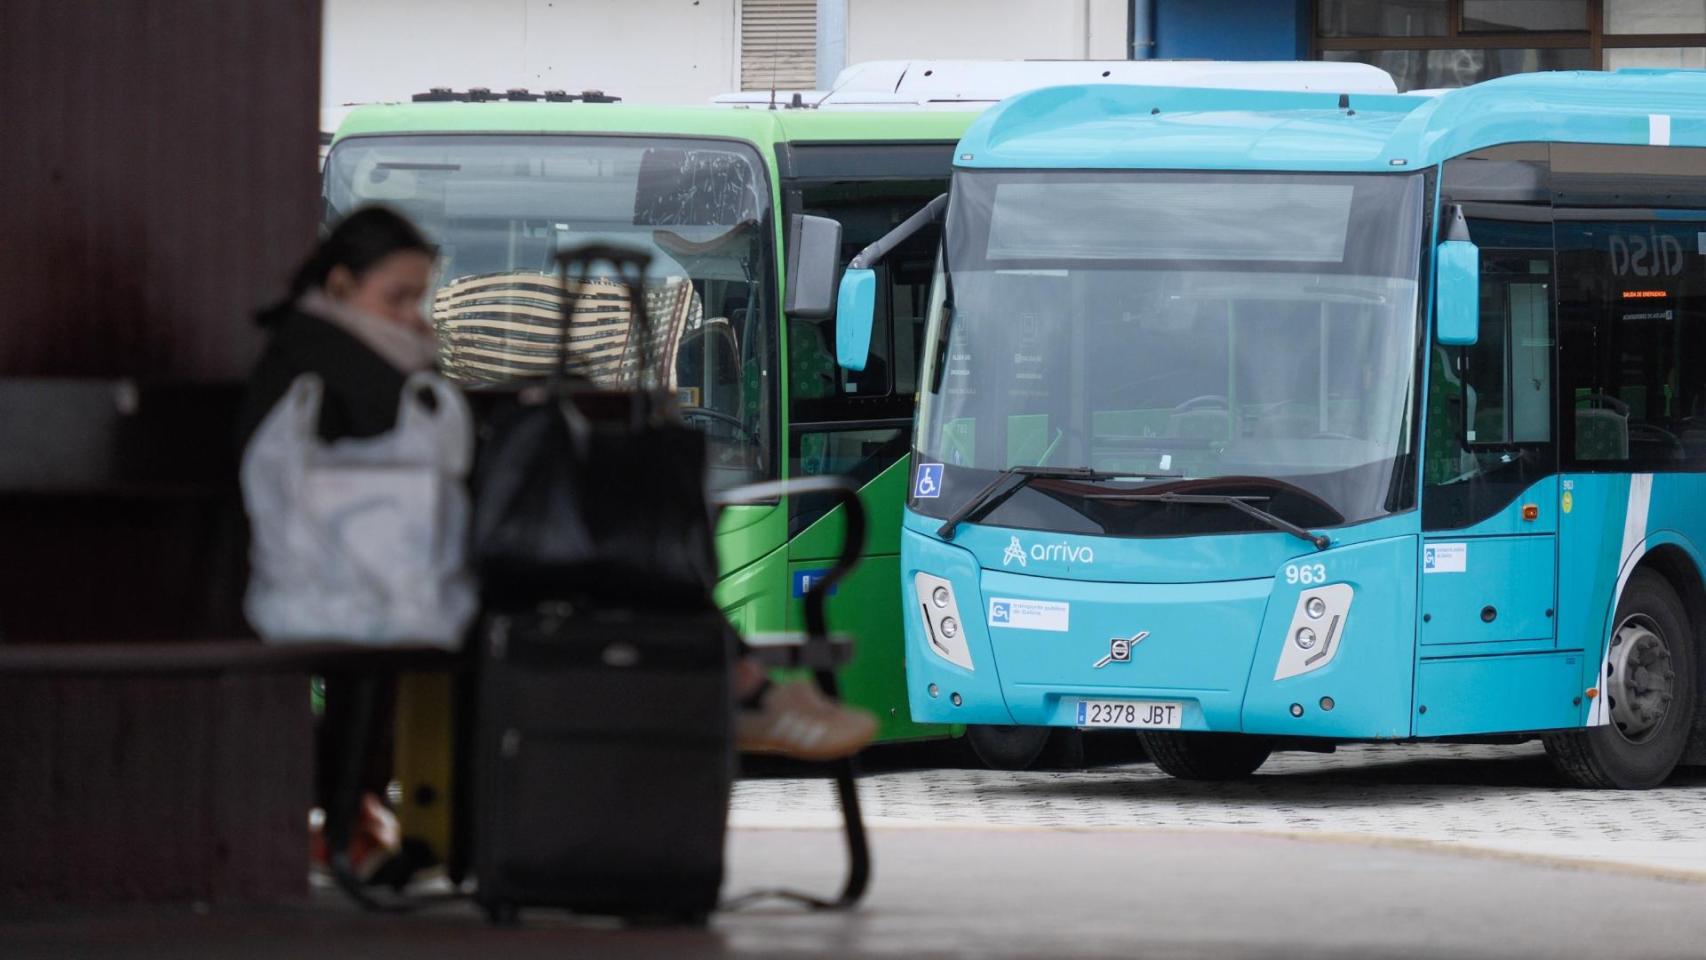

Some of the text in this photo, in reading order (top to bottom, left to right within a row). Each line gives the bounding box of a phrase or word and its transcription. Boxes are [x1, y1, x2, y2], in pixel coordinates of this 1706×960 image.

[1031, 541, 1094, 564] arriva
[1285, 564, 1326, 585] 963
[1090, 703, 1176, 725] 2378 JBT
